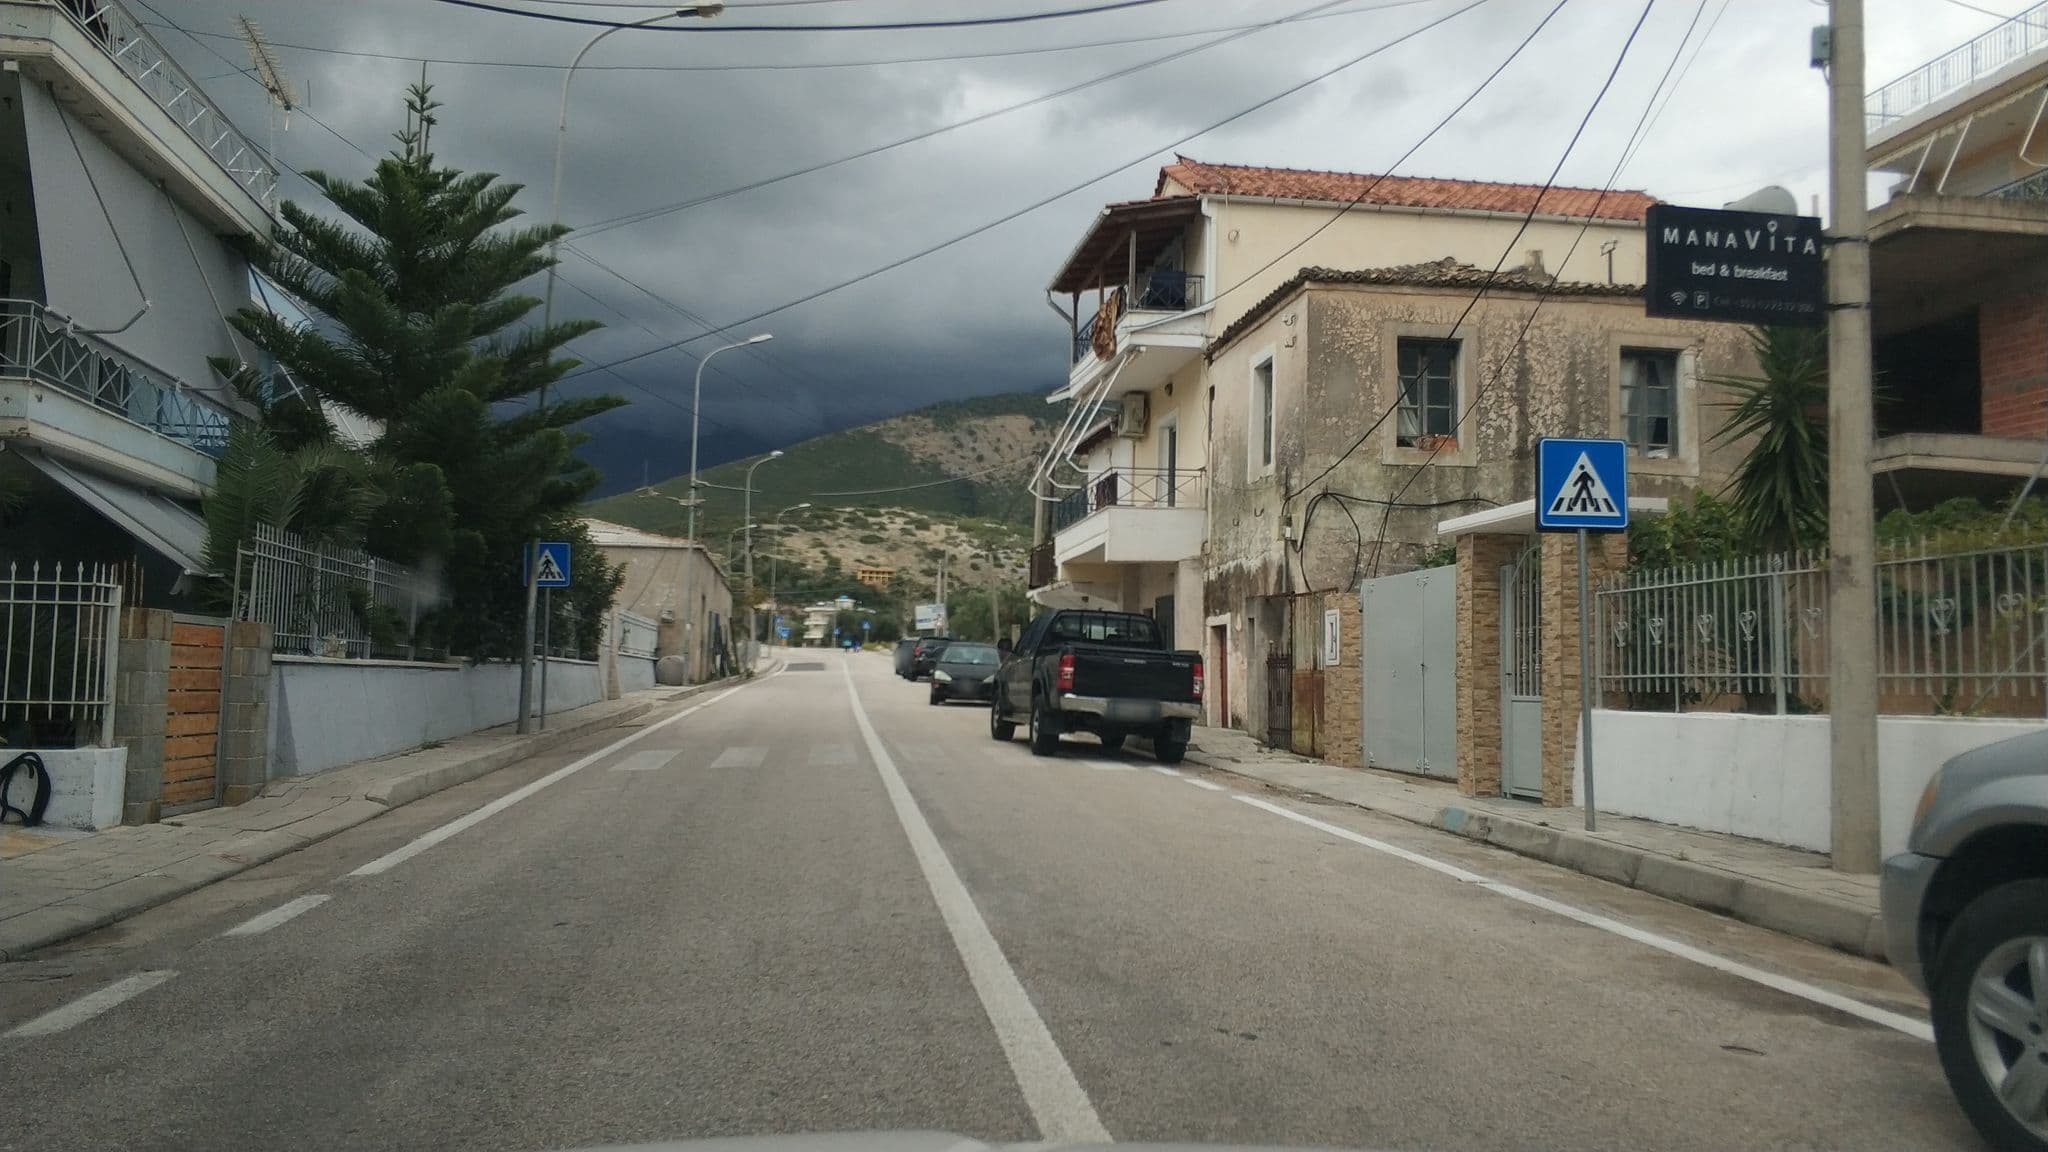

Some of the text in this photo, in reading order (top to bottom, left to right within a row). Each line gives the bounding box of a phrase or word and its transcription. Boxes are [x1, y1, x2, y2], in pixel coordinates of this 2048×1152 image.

[1692, 261, 1788, 281] bed & breakfast
